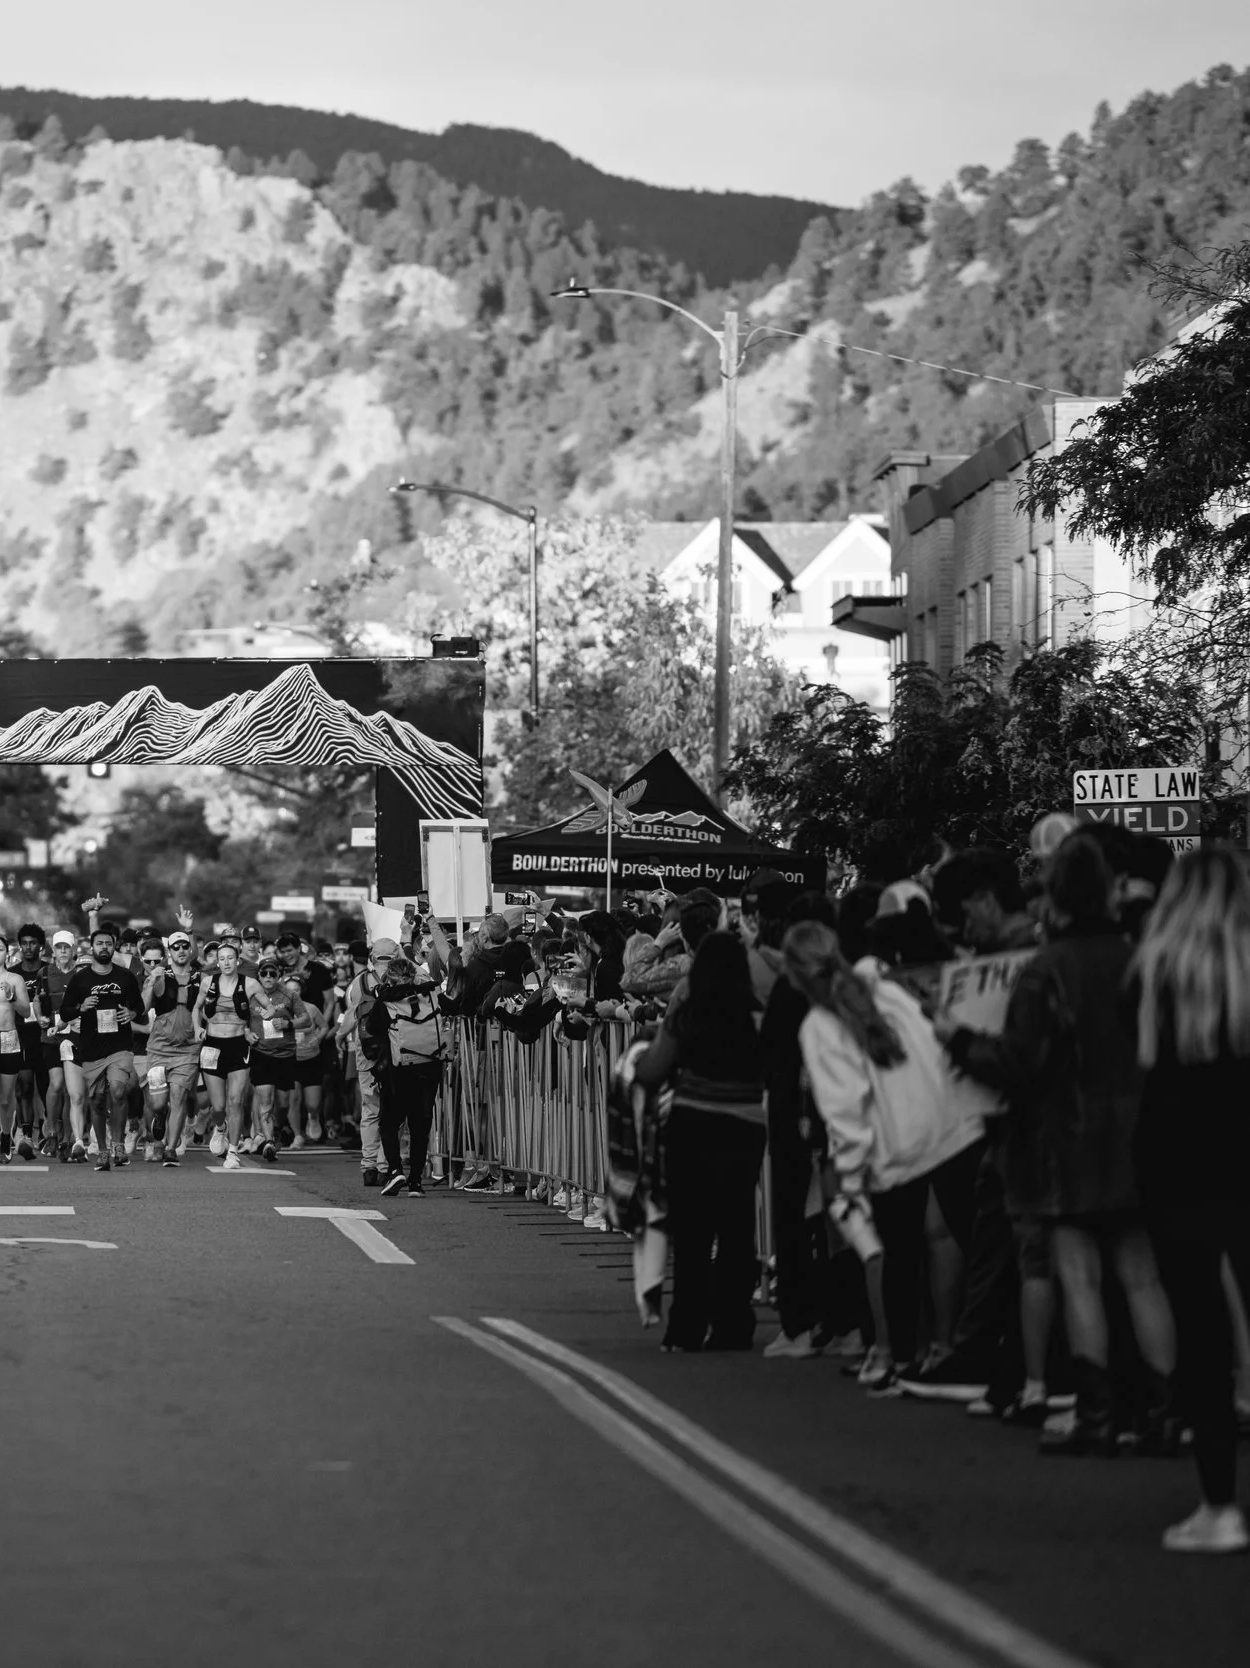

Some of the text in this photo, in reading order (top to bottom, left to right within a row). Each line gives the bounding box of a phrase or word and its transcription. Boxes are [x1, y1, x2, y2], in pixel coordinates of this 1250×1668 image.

[1076, 772, 1197, 800] STATE LAW
[1087, 806, 1189, 832] YIELD
[512, 853, 804, 885] BOULDERTHON presented by lulon
